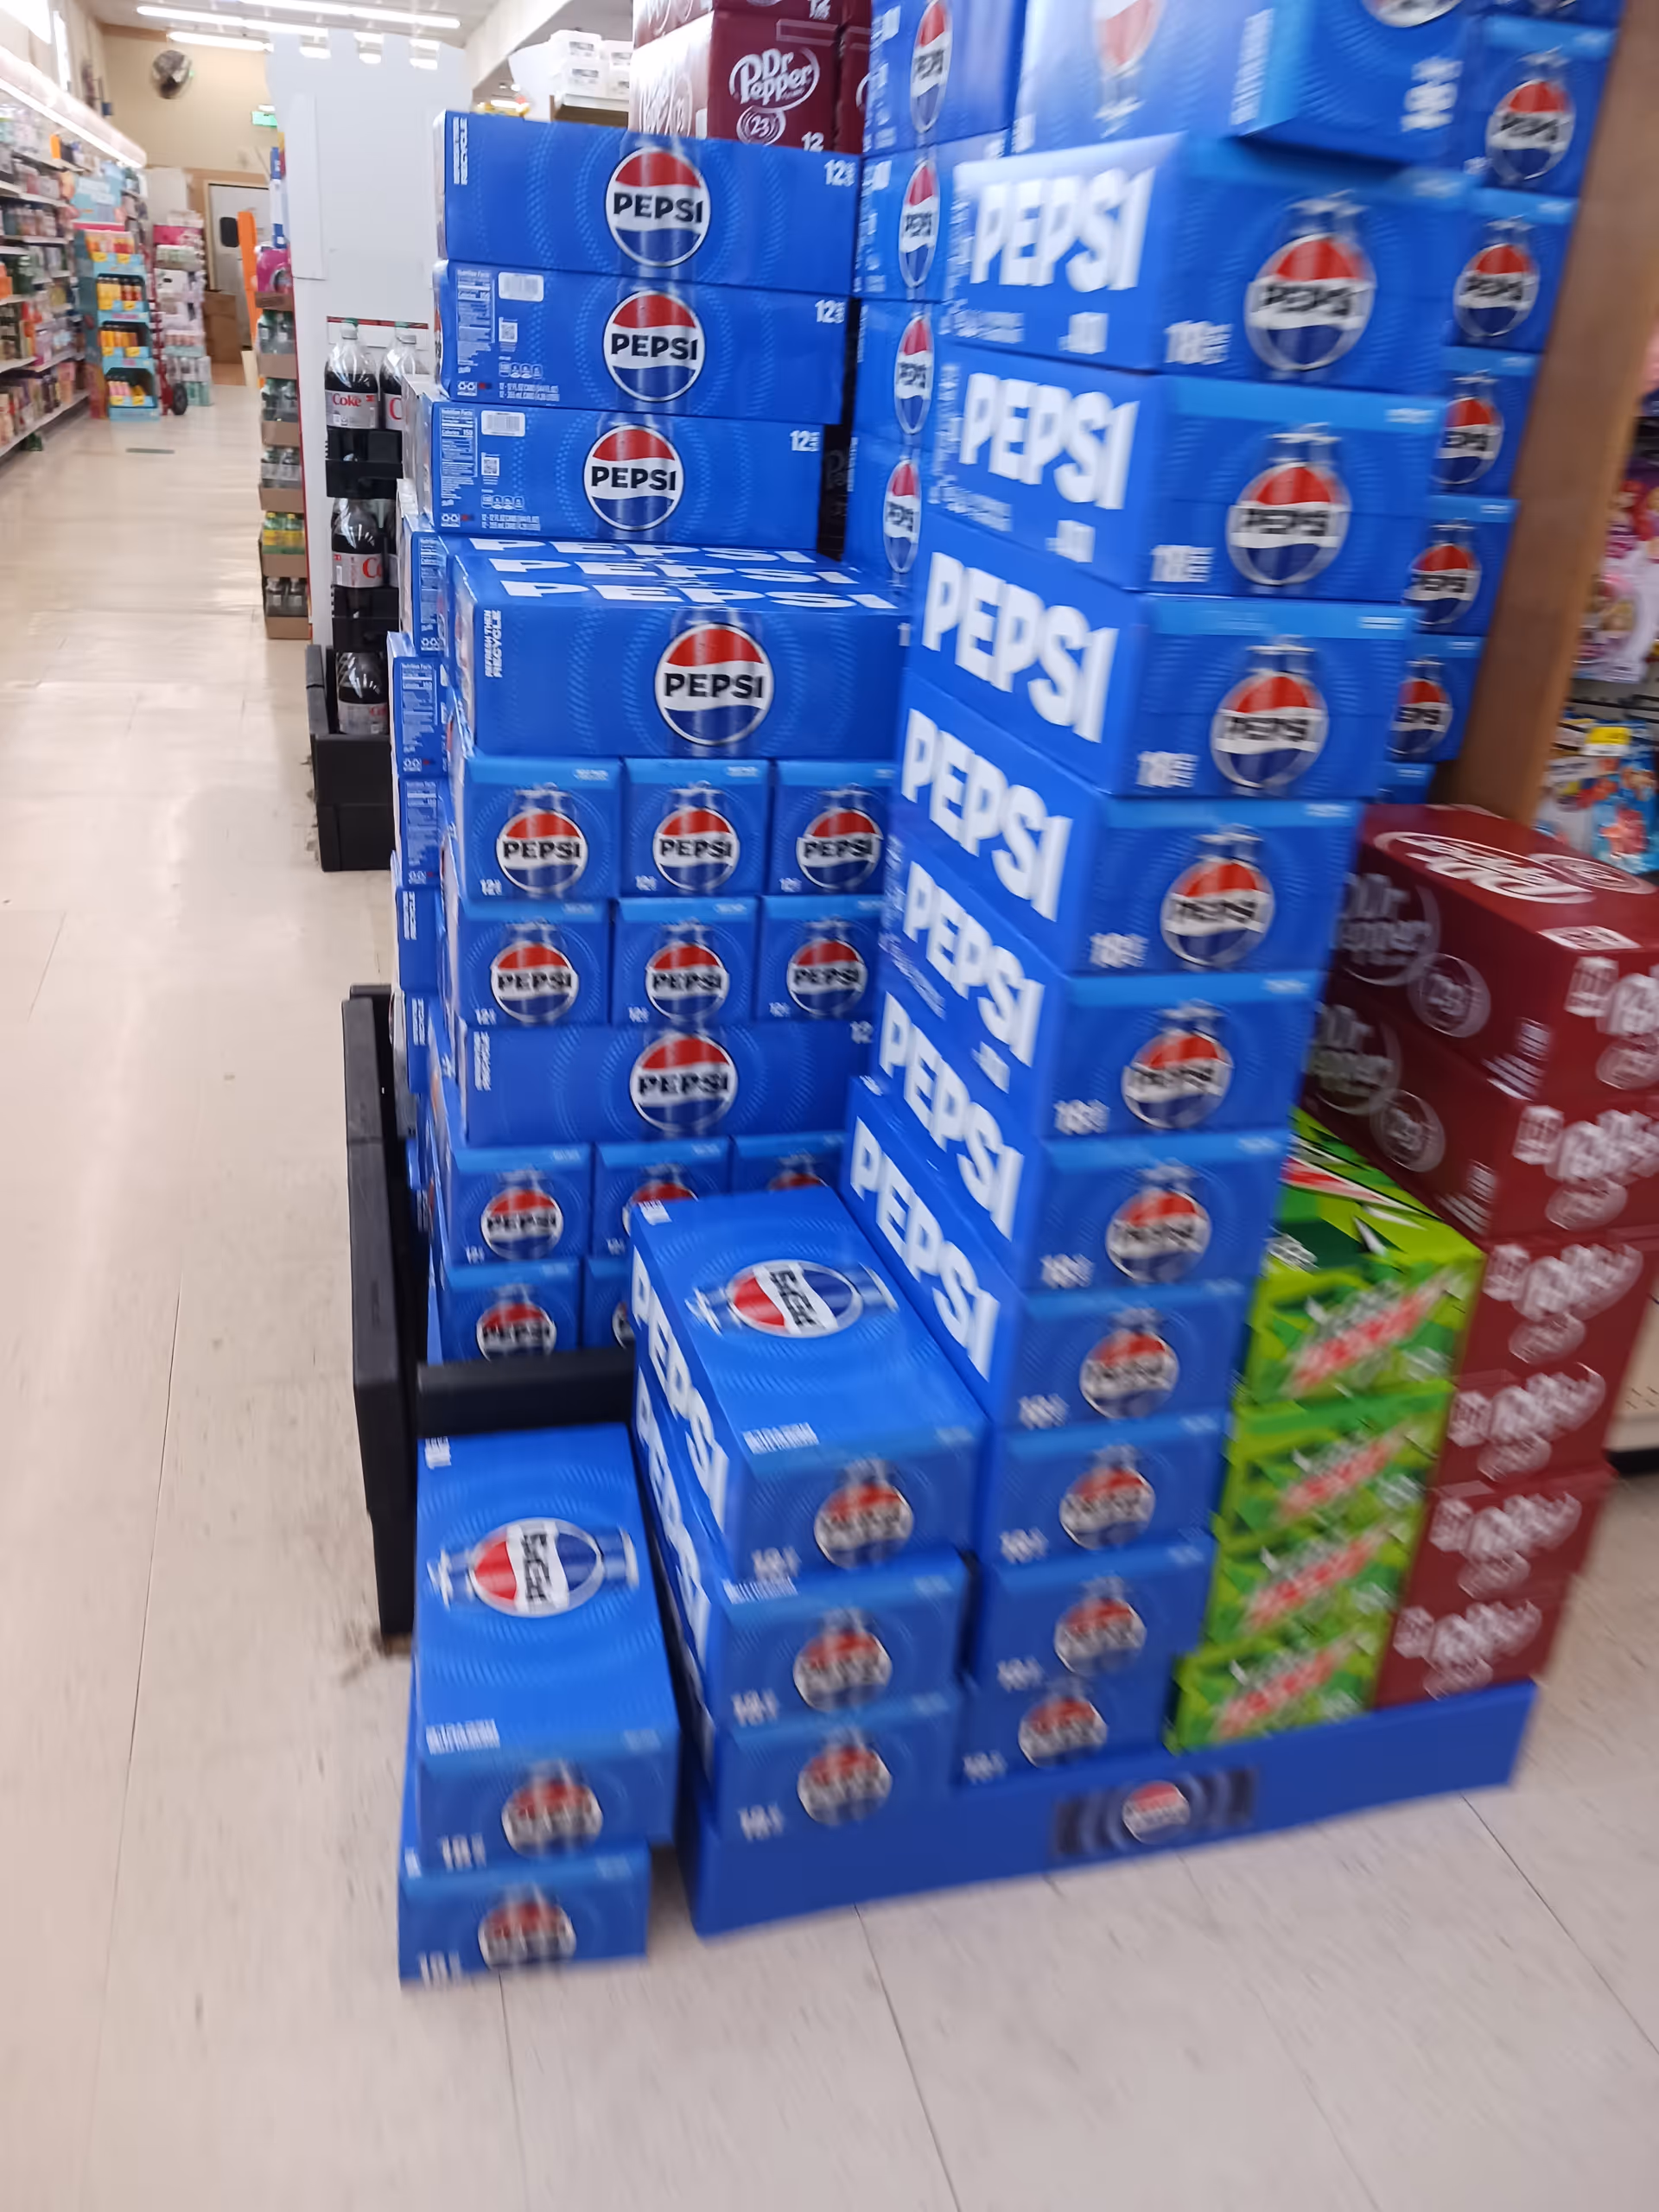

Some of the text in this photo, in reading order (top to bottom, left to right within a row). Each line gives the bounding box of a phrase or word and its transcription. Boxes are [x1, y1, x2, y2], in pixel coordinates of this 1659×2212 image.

[762, 48, 794, 75] Dr
[740, 54, 812, 105] Pepper
[751, 115, 770, 137] 23
[802, 131, 824, 152] 12
[613, 193, 704, 224] PEPSI
[969, 167, 1156, 293] PEPSI
[815, 300, 836, 323] 12
[610, 334, 699, 361] PEPSI
[333, 393, 361, 408] Coke
[790, 430, 810, 451] 12
[959, 372, 1141, 510] PEPSI
[591, 467, 677, 492] PEPSI
[468, 537, 817, 563] PEPSI
[488, 557, 861, 585] PEPSI
[499, 580, 899, 609] PEPSI
[484, 609, 493, 635] THEN
[492, 610, 503, 678] RECYCLE
[921, 551, 1120, 743] PEPSI
[664, 673, 763, 699] PEPSI
[901, 708, 1074, 922] PEPSI
[503, 840, 582, 859] PEPSI
[658, 838, 733, 859] PEPSI
[803, 838, 873, 859] PEPSI
[792, 967, 860, 988] PEPSI
[903, 861, 1045, 1068] PEPSI
[498, 972, 572, 992] PEPSI
[652, 973, 722, 993] PEPSI
[638, 1071, 729, 1098] PEPSI
[878, 991, 1025, 1241] PEPSI
[850, 1116, 1001, 1382] PEPSI
[632, 1246, 729, 1534] PEPSI
[635, 1365, 710, 1676] PEPSI
